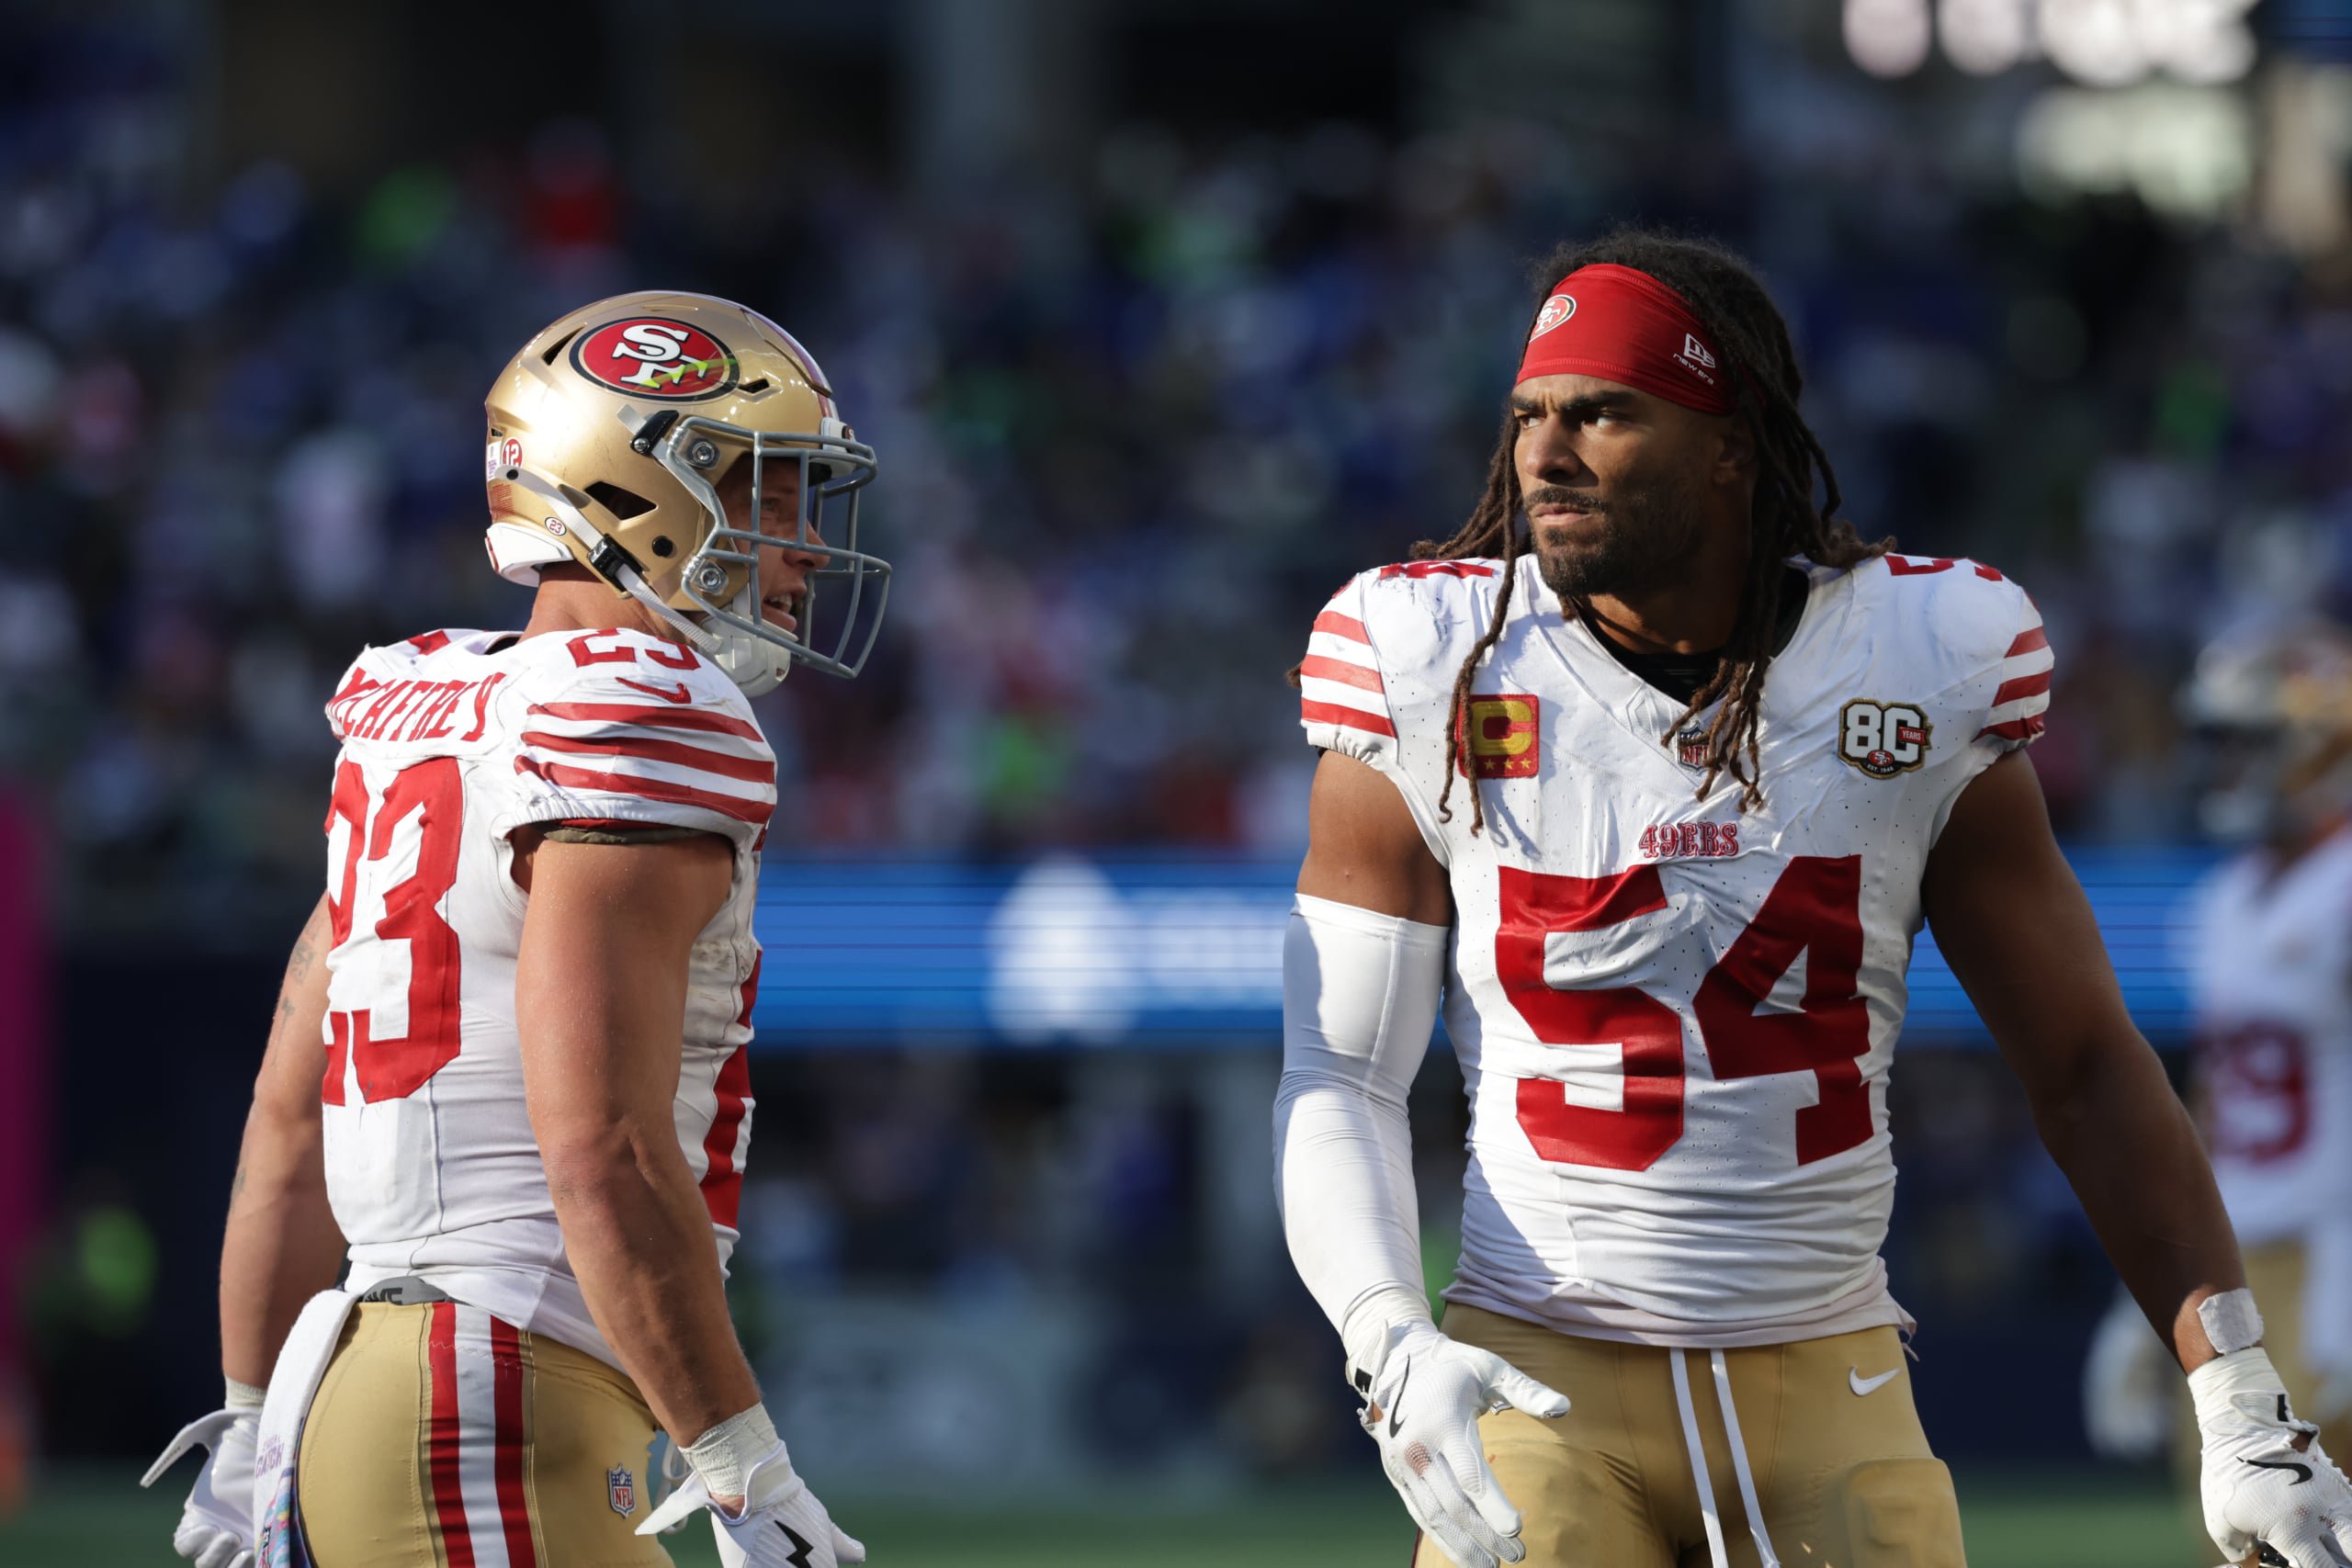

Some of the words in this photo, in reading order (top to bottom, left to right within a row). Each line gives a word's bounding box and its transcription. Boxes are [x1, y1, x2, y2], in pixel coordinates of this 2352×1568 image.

[612, 324, 709, 390] SF
[504, 443, 520, 468] 12
[548, 518, 563, 534] 23
[1470, 700, 1532, 756] C
[1902, 729, 1922, 741] YEARS
[1639, 821, 1739, 858] 49ERS
[322, 756, 463, 1106] 23
[1495, 854, 1873, 1172] 54
[615, 1487, 633, 1508] NFL
